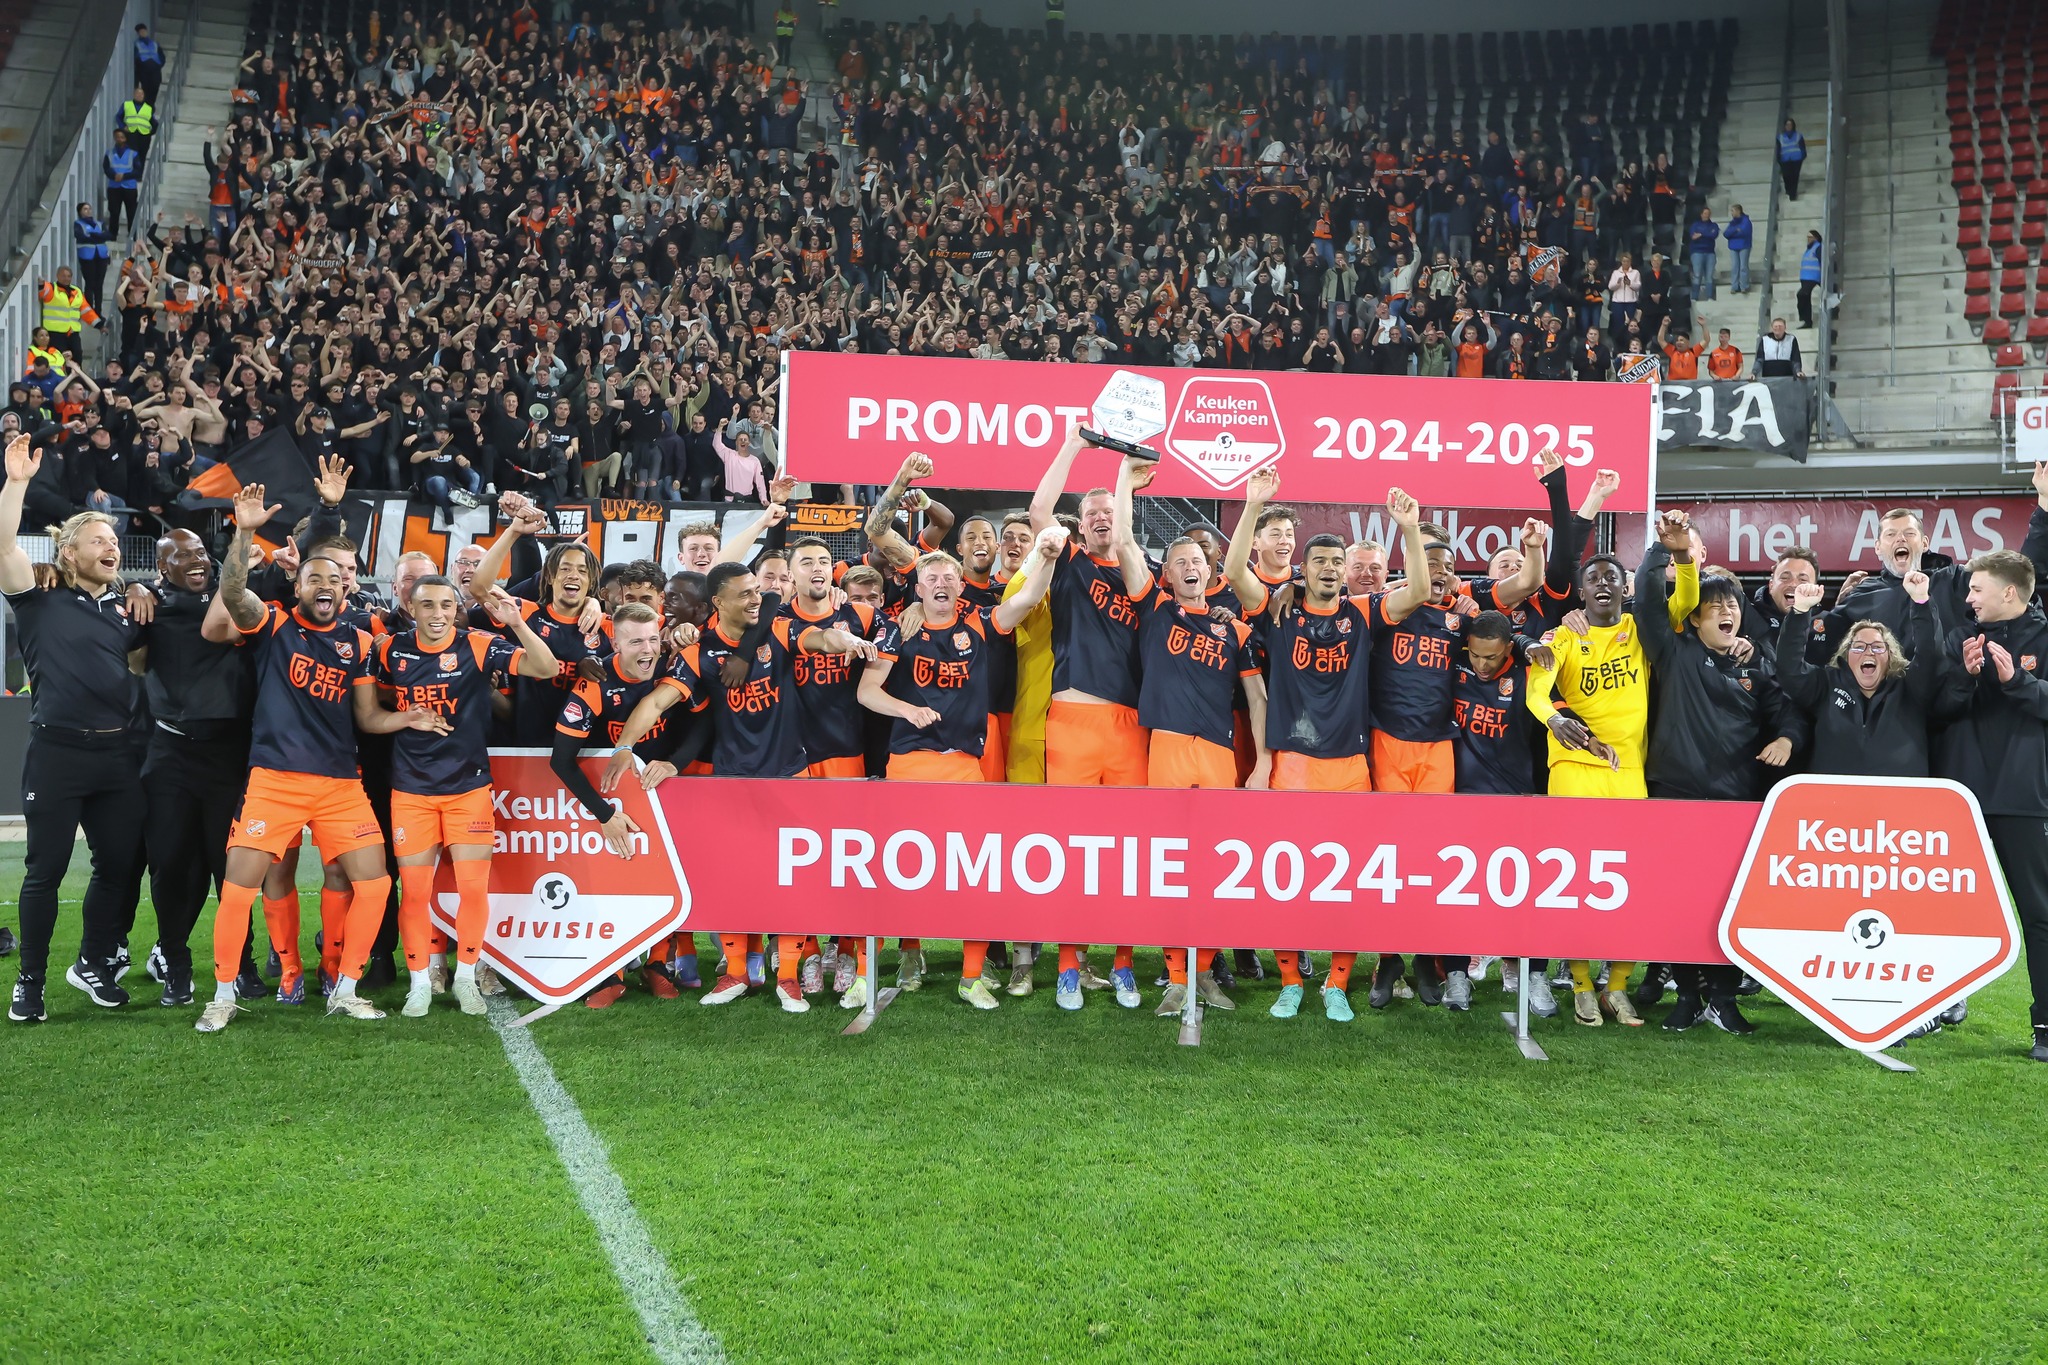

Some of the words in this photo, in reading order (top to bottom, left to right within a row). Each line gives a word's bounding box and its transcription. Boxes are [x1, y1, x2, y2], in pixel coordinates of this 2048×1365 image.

[1196, 395, 1258, 411] Keuken
[1184, 410, 1269, 428] Kampioen
[2023, 406, 2048, 429] G
[1313, 416, 1596, 467] 2024-2025
[1199, 450, 1252, 463] divisie
[797, 508, 857, 525] ULTRAS
[1729, 508, 1818, 563] het
[1848, 506, 2004, 563] AAS
[1193, 634, 1226, 654] BET
[1315, 641, 1348, 658] BET
[1418, 636, 1451, 655] BET
[939, 661, 969, 676] BET
[1189, 649, 1228, 671] CITY
[1315, 654, 1350, 673] CITY
[1416, 652, 1452, 671] CITY
[1600, 655, 1632, 677] BET
[315, 663, 347, 686] BET
[813, 667, 850, 685] CITY
[1603, 669, 1639, 690] CITY
[309, 680, 347, 704] CITY
[413, 683, 449, 702] BET
[746, 686, 780, 713] CITY
[1472, 704, 1506, 724] BET
[1469, 720, 1509, 739] CITY
[26, 792, 36, 801] JS
[1797, 819, 1949, 856] Keuken
[778, 827, 1189, 899] PROMOTIE
[1213, 839, 1629, 911] 2024-2025
[1768, 854, 1976, 898] Kampioen
[496, 915, 615, 940] divisie
[1802, 955, 1935, 983] divisie
